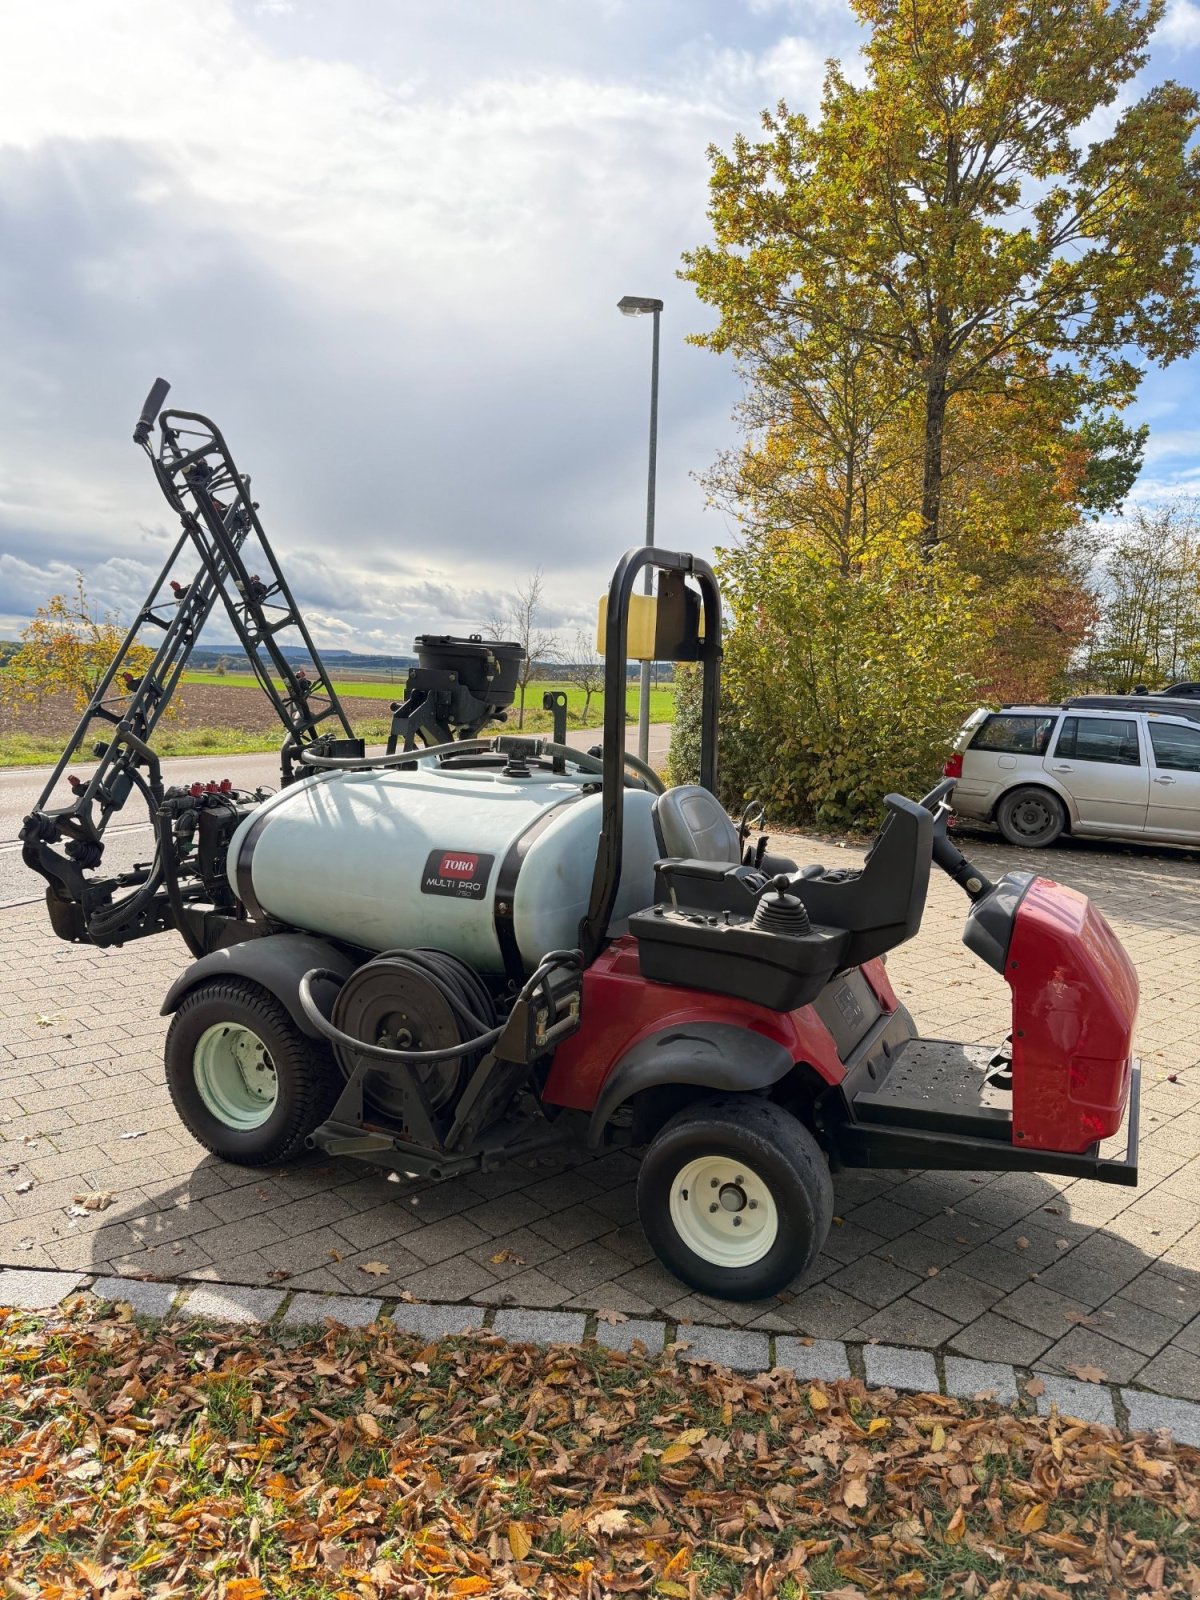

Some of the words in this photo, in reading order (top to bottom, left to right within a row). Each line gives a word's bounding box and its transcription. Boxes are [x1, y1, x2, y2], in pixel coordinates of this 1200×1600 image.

[444, 860, 474, 871] TORO
[426, 878, 455, 888] MULTI
[458, 881, 481, 891] PRO
